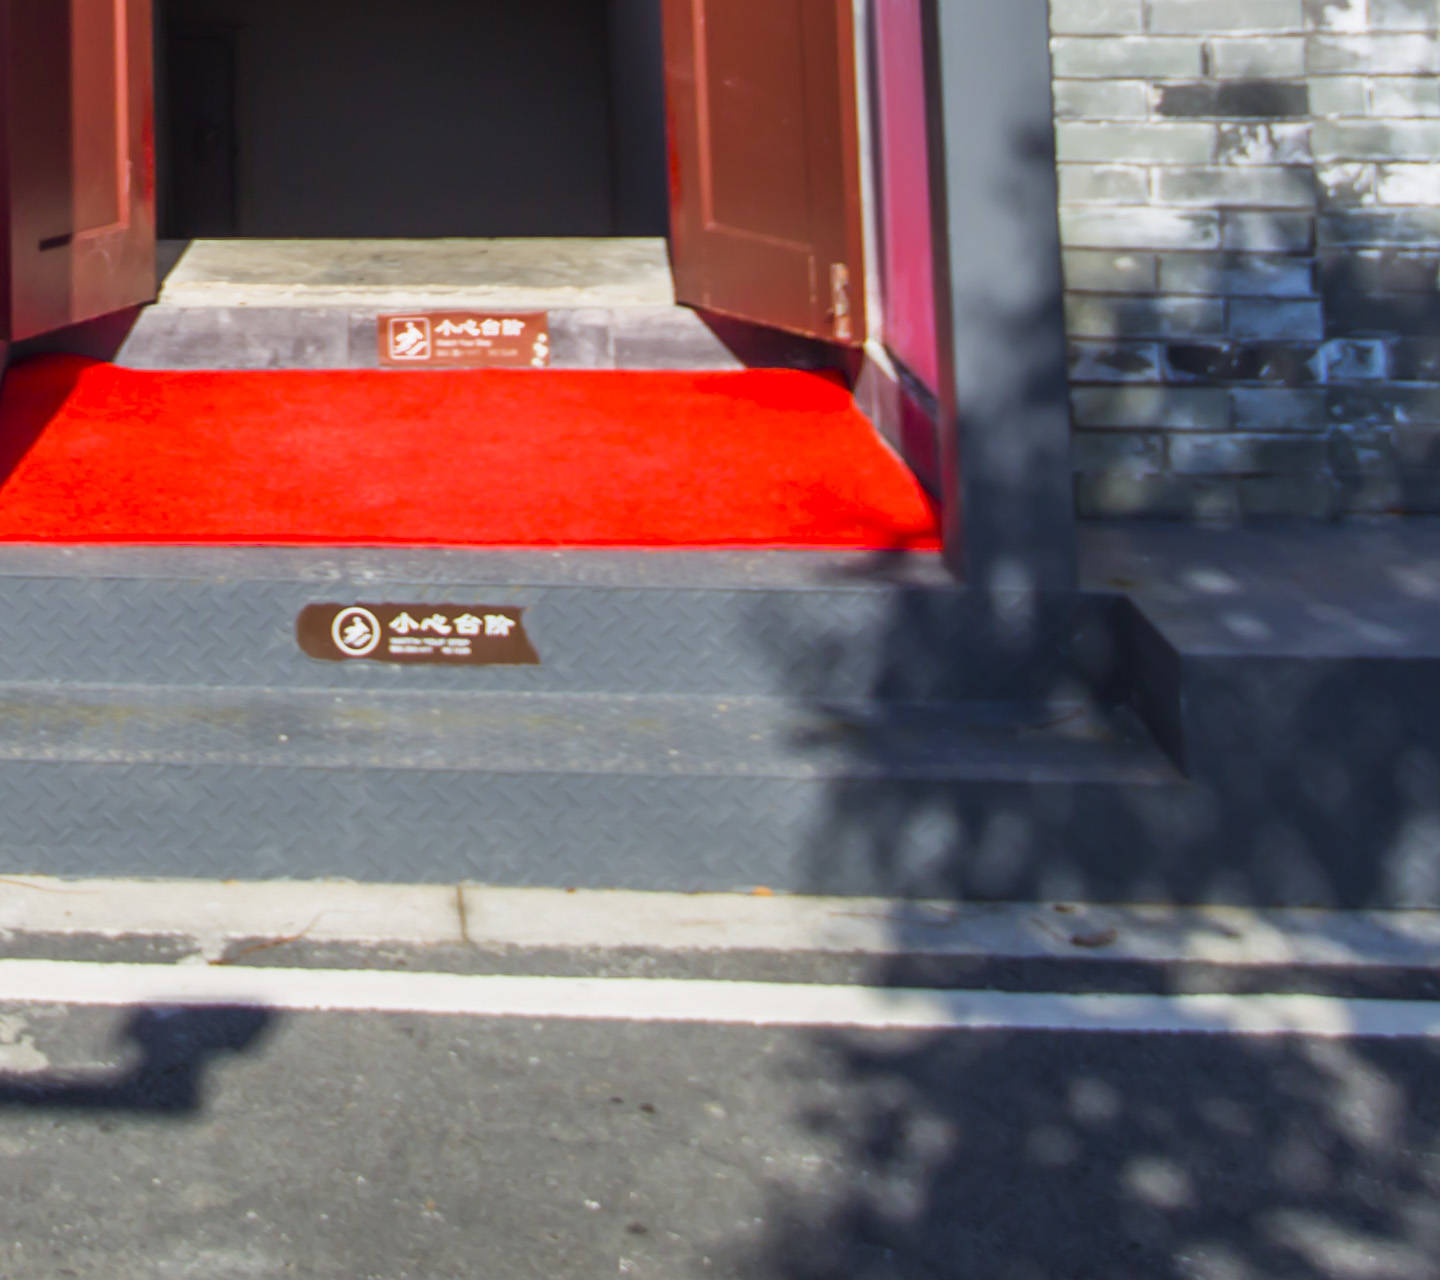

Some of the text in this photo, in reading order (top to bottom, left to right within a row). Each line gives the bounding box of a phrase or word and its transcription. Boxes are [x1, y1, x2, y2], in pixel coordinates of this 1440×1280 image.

[434, 318, 526, 336] 小心台阶
[387, 611, 517, 636] 小心台阶
